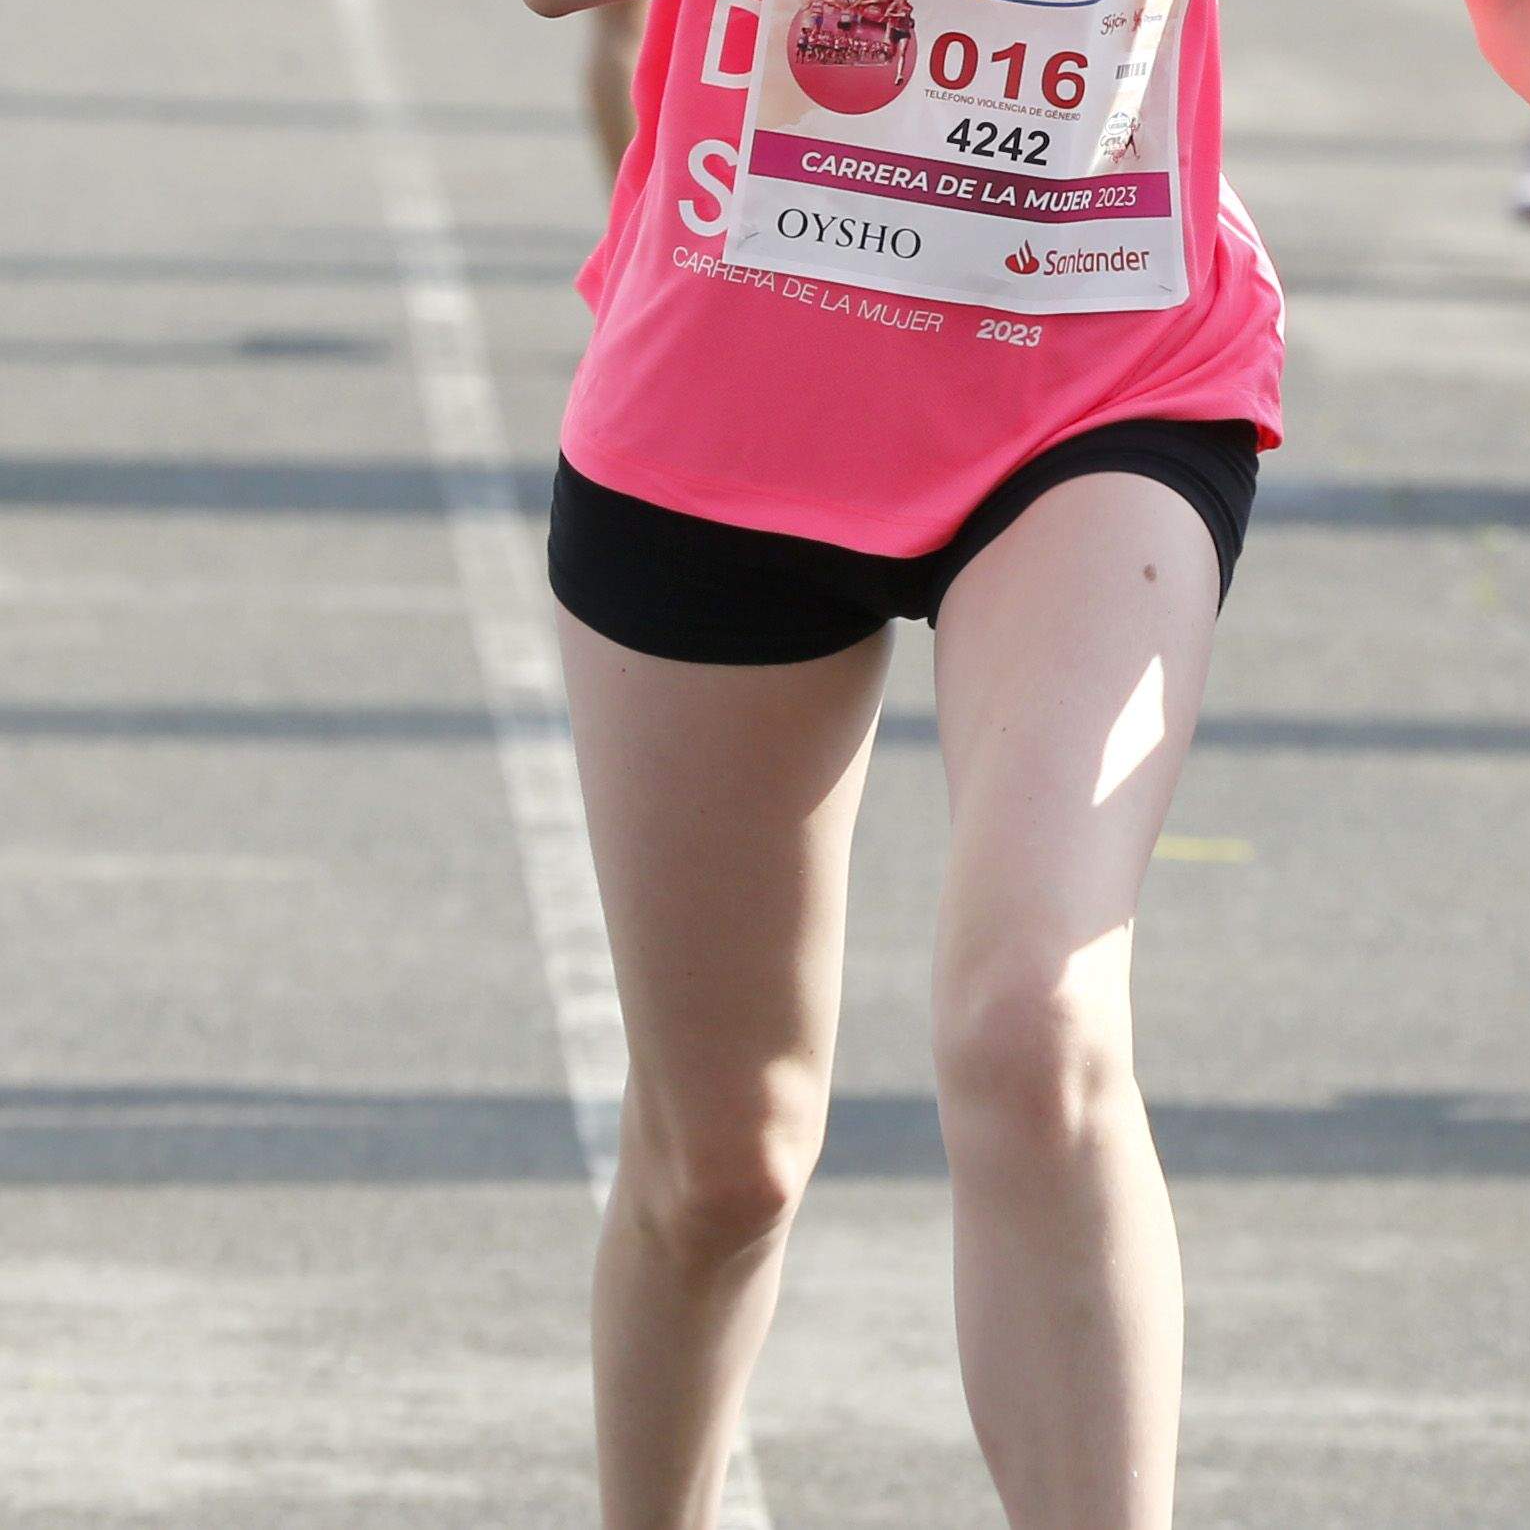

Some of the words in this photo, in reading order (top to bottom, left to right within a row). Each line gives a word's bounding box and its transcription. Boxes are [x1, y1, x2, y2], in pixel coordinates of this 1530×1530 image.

[924, 89, 975, 105] TELÉFONO
[977, 98, 1027, 114] VIOLENCIA
[1029, 107, 1042, 117] DE
[929, 31, 1089, 110] 016
[947, 118, 1051, 166] 4242
[801, 150, 930, 193] CARRERA
[936, 176, 975, 201] DE
[979, 182, 1018, 208] LA
[1026, 188, 1093, 214] MUJER
[1095, 185, 1139, 210] 2023
[776, 207, 923, 261] OYSHO
[1042, 244, 1151, 277] Santander
[782, 277, 818, 305] DE
[820, 289, 851, 315] LA
[857, 299, 945, 334] MUJER
[975, 318, 1044, 348] 2023
